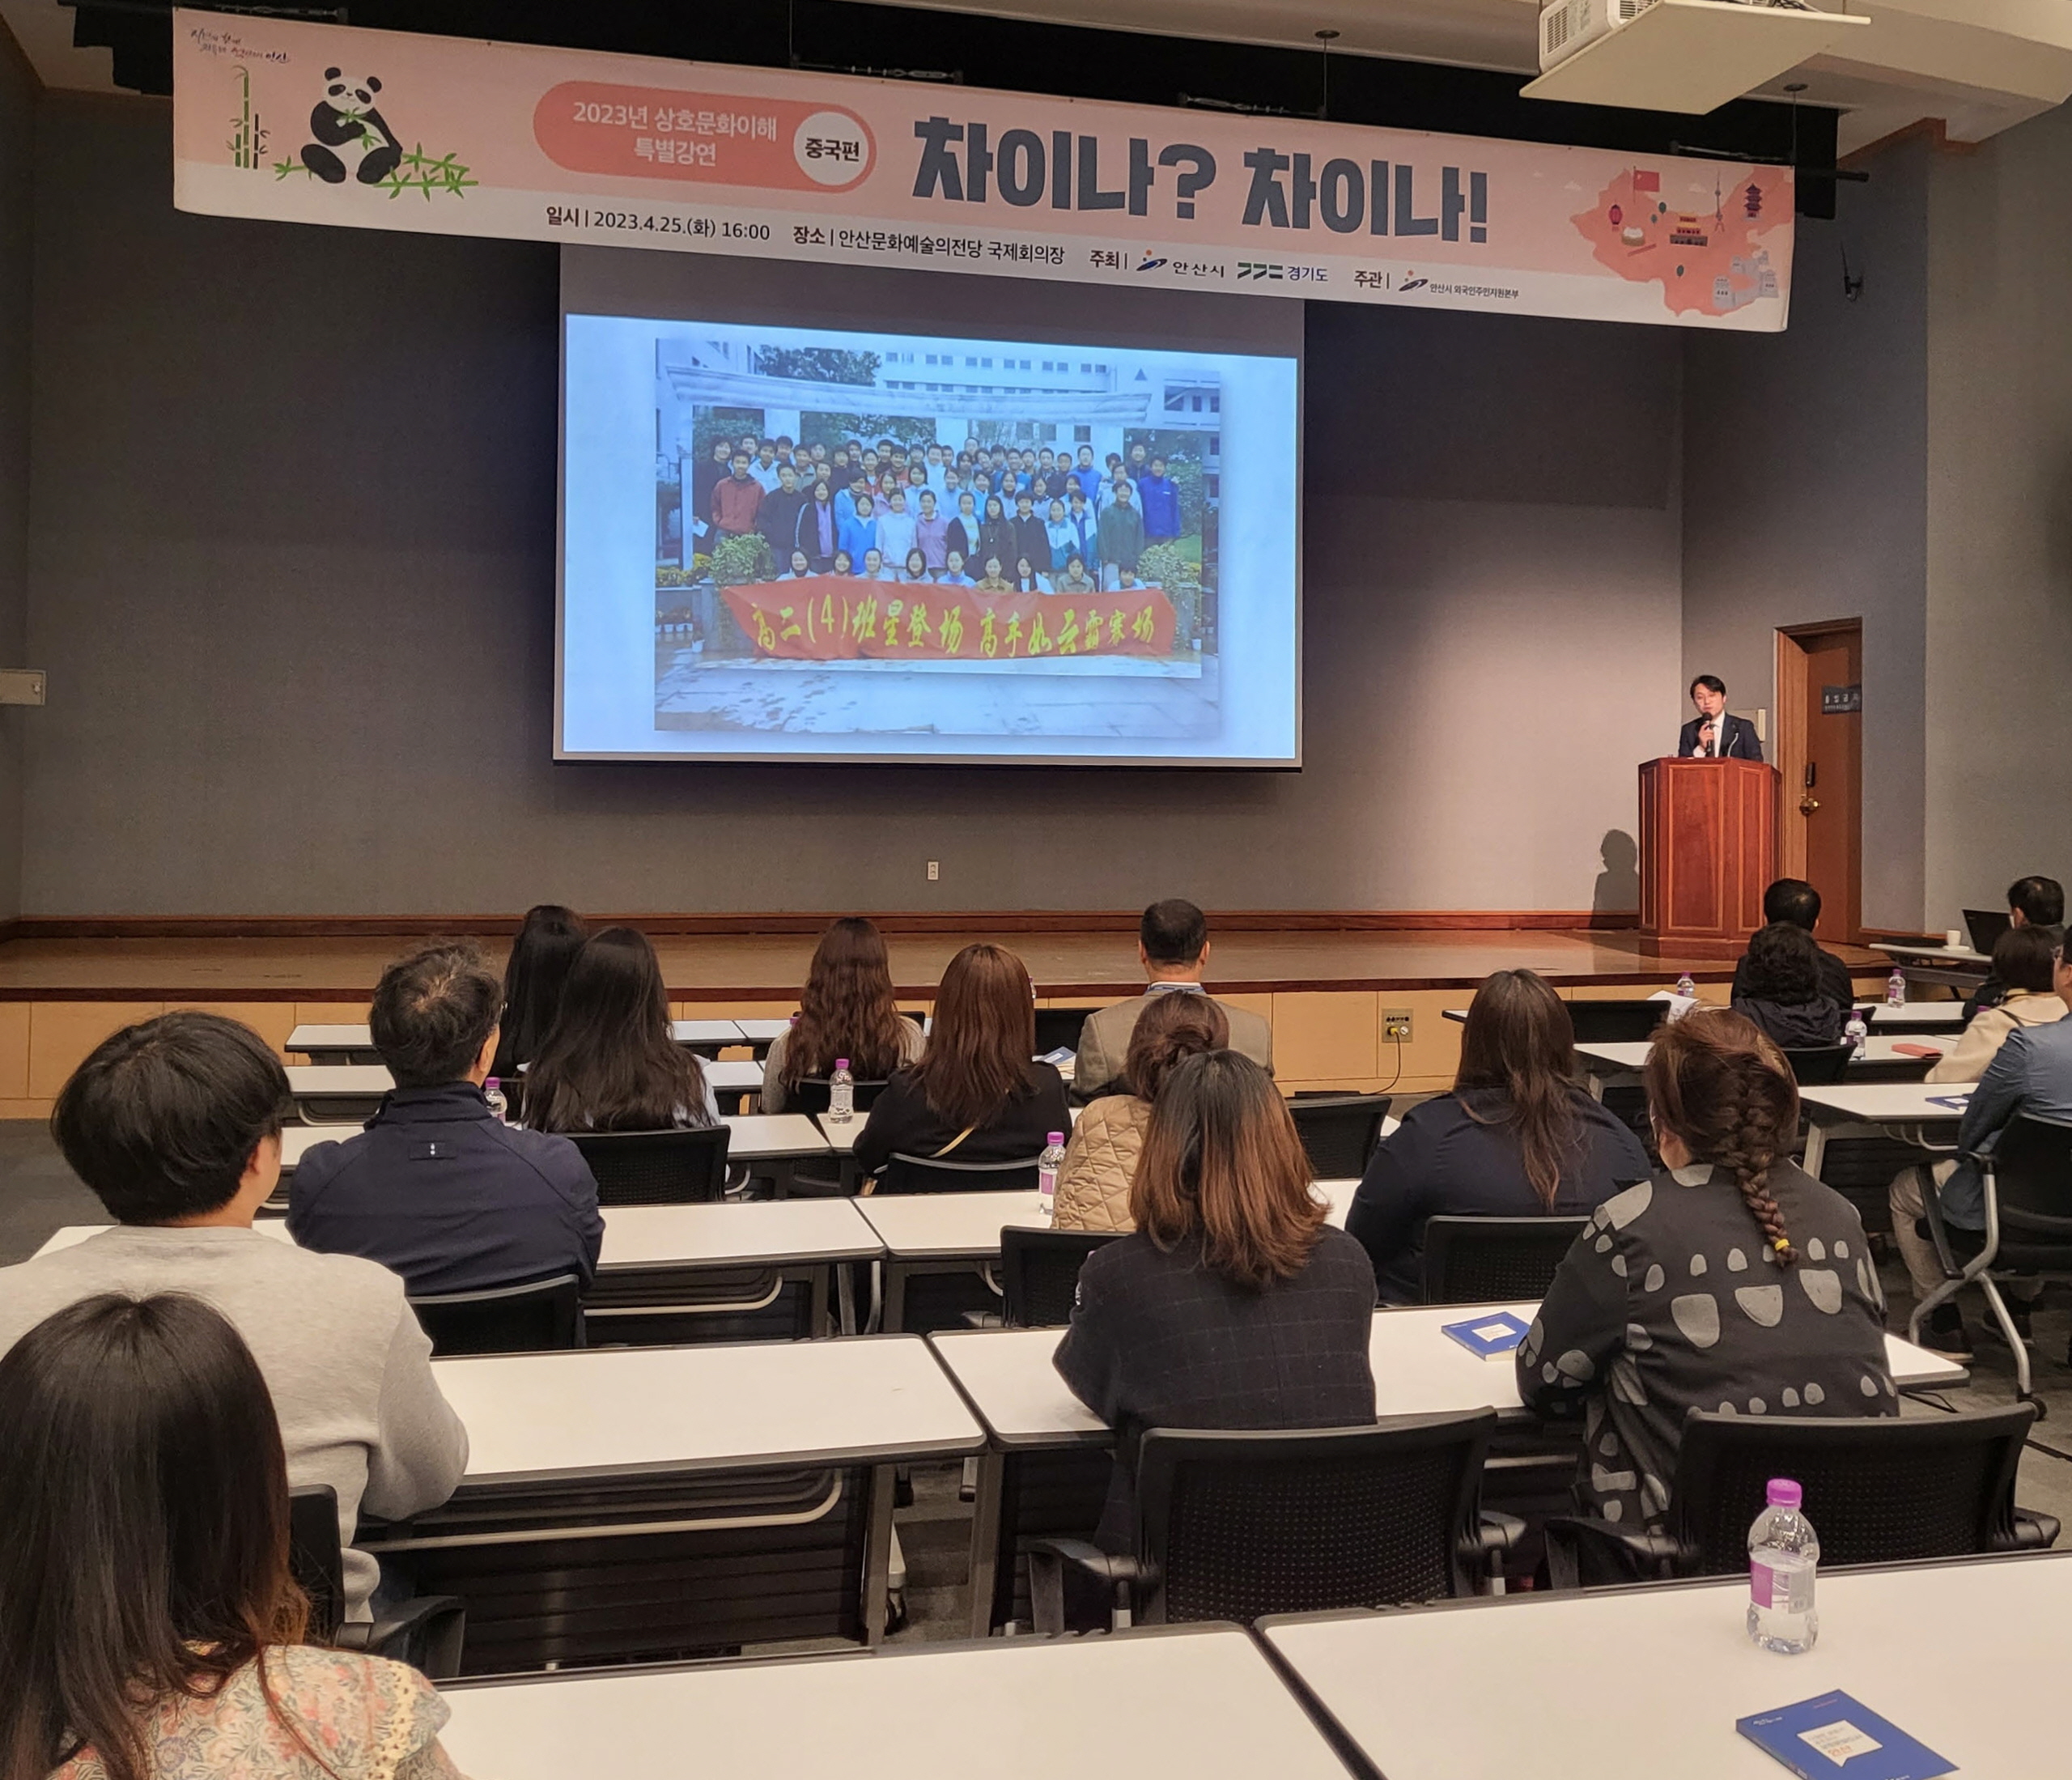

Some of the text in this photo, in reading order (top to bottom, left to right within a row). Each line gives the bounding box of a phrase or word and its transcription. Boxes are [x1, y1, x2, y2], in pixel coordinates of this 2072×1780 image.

[572, 102, 777, 142] 2023년 상호문화이해
[634, 137, 717, 167] 특별강연
[805, 137, 860, 163] 중국편
[911, 116, 1488, 244] 차이나? 차이나!
[546, 206, 580, 227] 일시
[593, 211, 716, 238] 2023.4.25.(화)
[721, 221, 771, 240] 16:00
[792, 225, 826, 244] 장소
[839, 229, 983, 259] 안산문화예술의전당
[987, 240, 1065, 265] 국제회의장
[1089, 249, 1120, 270] 주최
[1172, 261, 1225, 278] 안산시
[1287, 265, 1329, 282] 경기도
[1354, 270, 1382, 289] 주관
